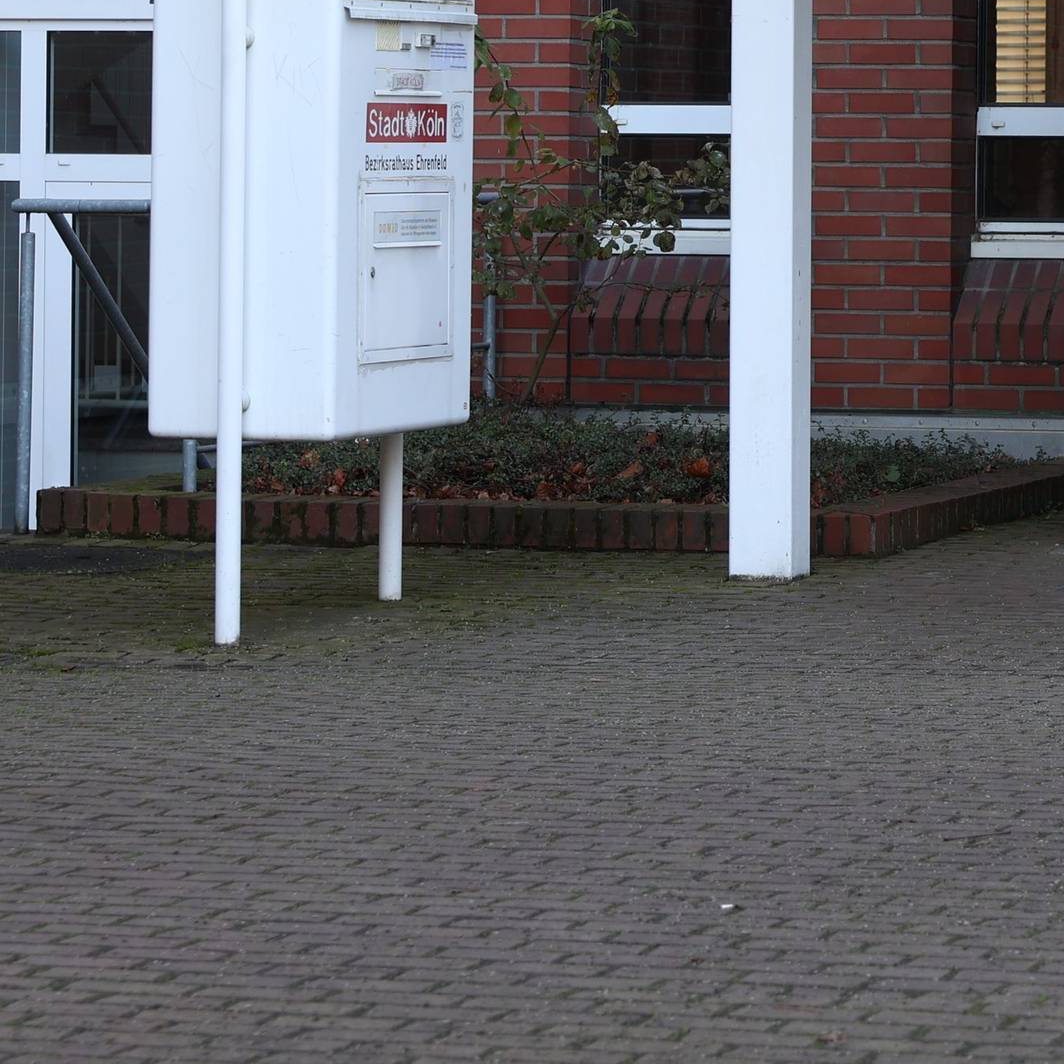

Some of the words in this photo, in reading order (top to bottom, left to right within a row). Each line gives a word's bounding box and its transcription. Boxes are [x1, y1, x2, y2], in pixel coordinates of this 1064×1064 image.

[369, 108, 405, 137] Stadt
[417, 108, 445, 137] Köln
[365, 155, 413, 172] Bezirksrathaus
[416, 153, 448, 171] Ehrenfeld
